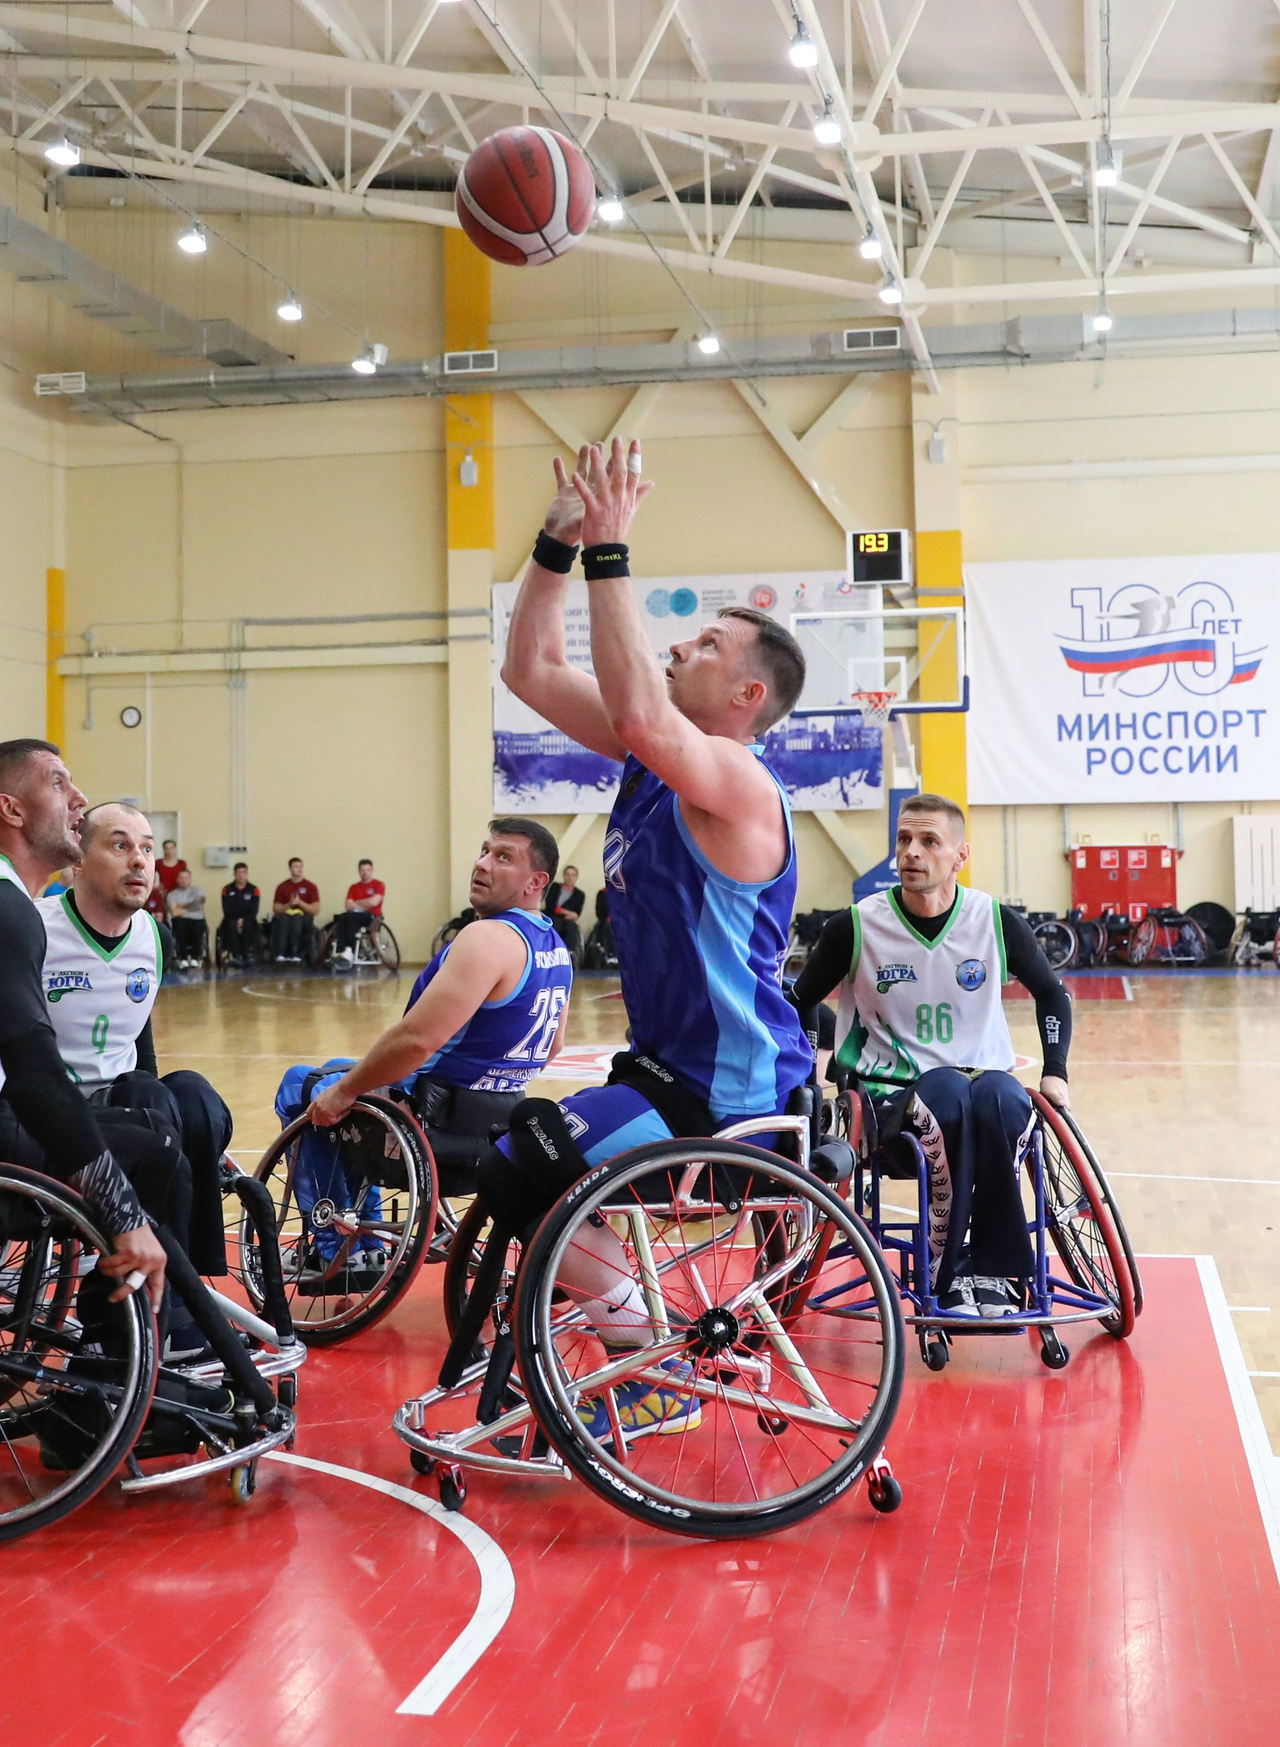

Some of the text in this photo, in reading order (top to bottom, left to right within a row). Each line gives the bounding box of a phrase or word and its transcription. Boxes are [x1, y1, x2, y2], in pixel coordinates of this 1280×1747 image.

[1201, 619, 1243, 635] ЛЕТ
[1057, 709, 1267, 742] МИНСПОРТ
[1086, 745, 1239, 775] РОССИИ
[48, 975, 93, 990] ЮГРА
[876, 968, 918, 981] ЮГРА
[92, 1014, 109, 1054] 9
[916, 1002, 953, 1044] 86
[566, 1165, 610, 1204] KENDA
[587, 1459, 691, 1519] SPINERGY
